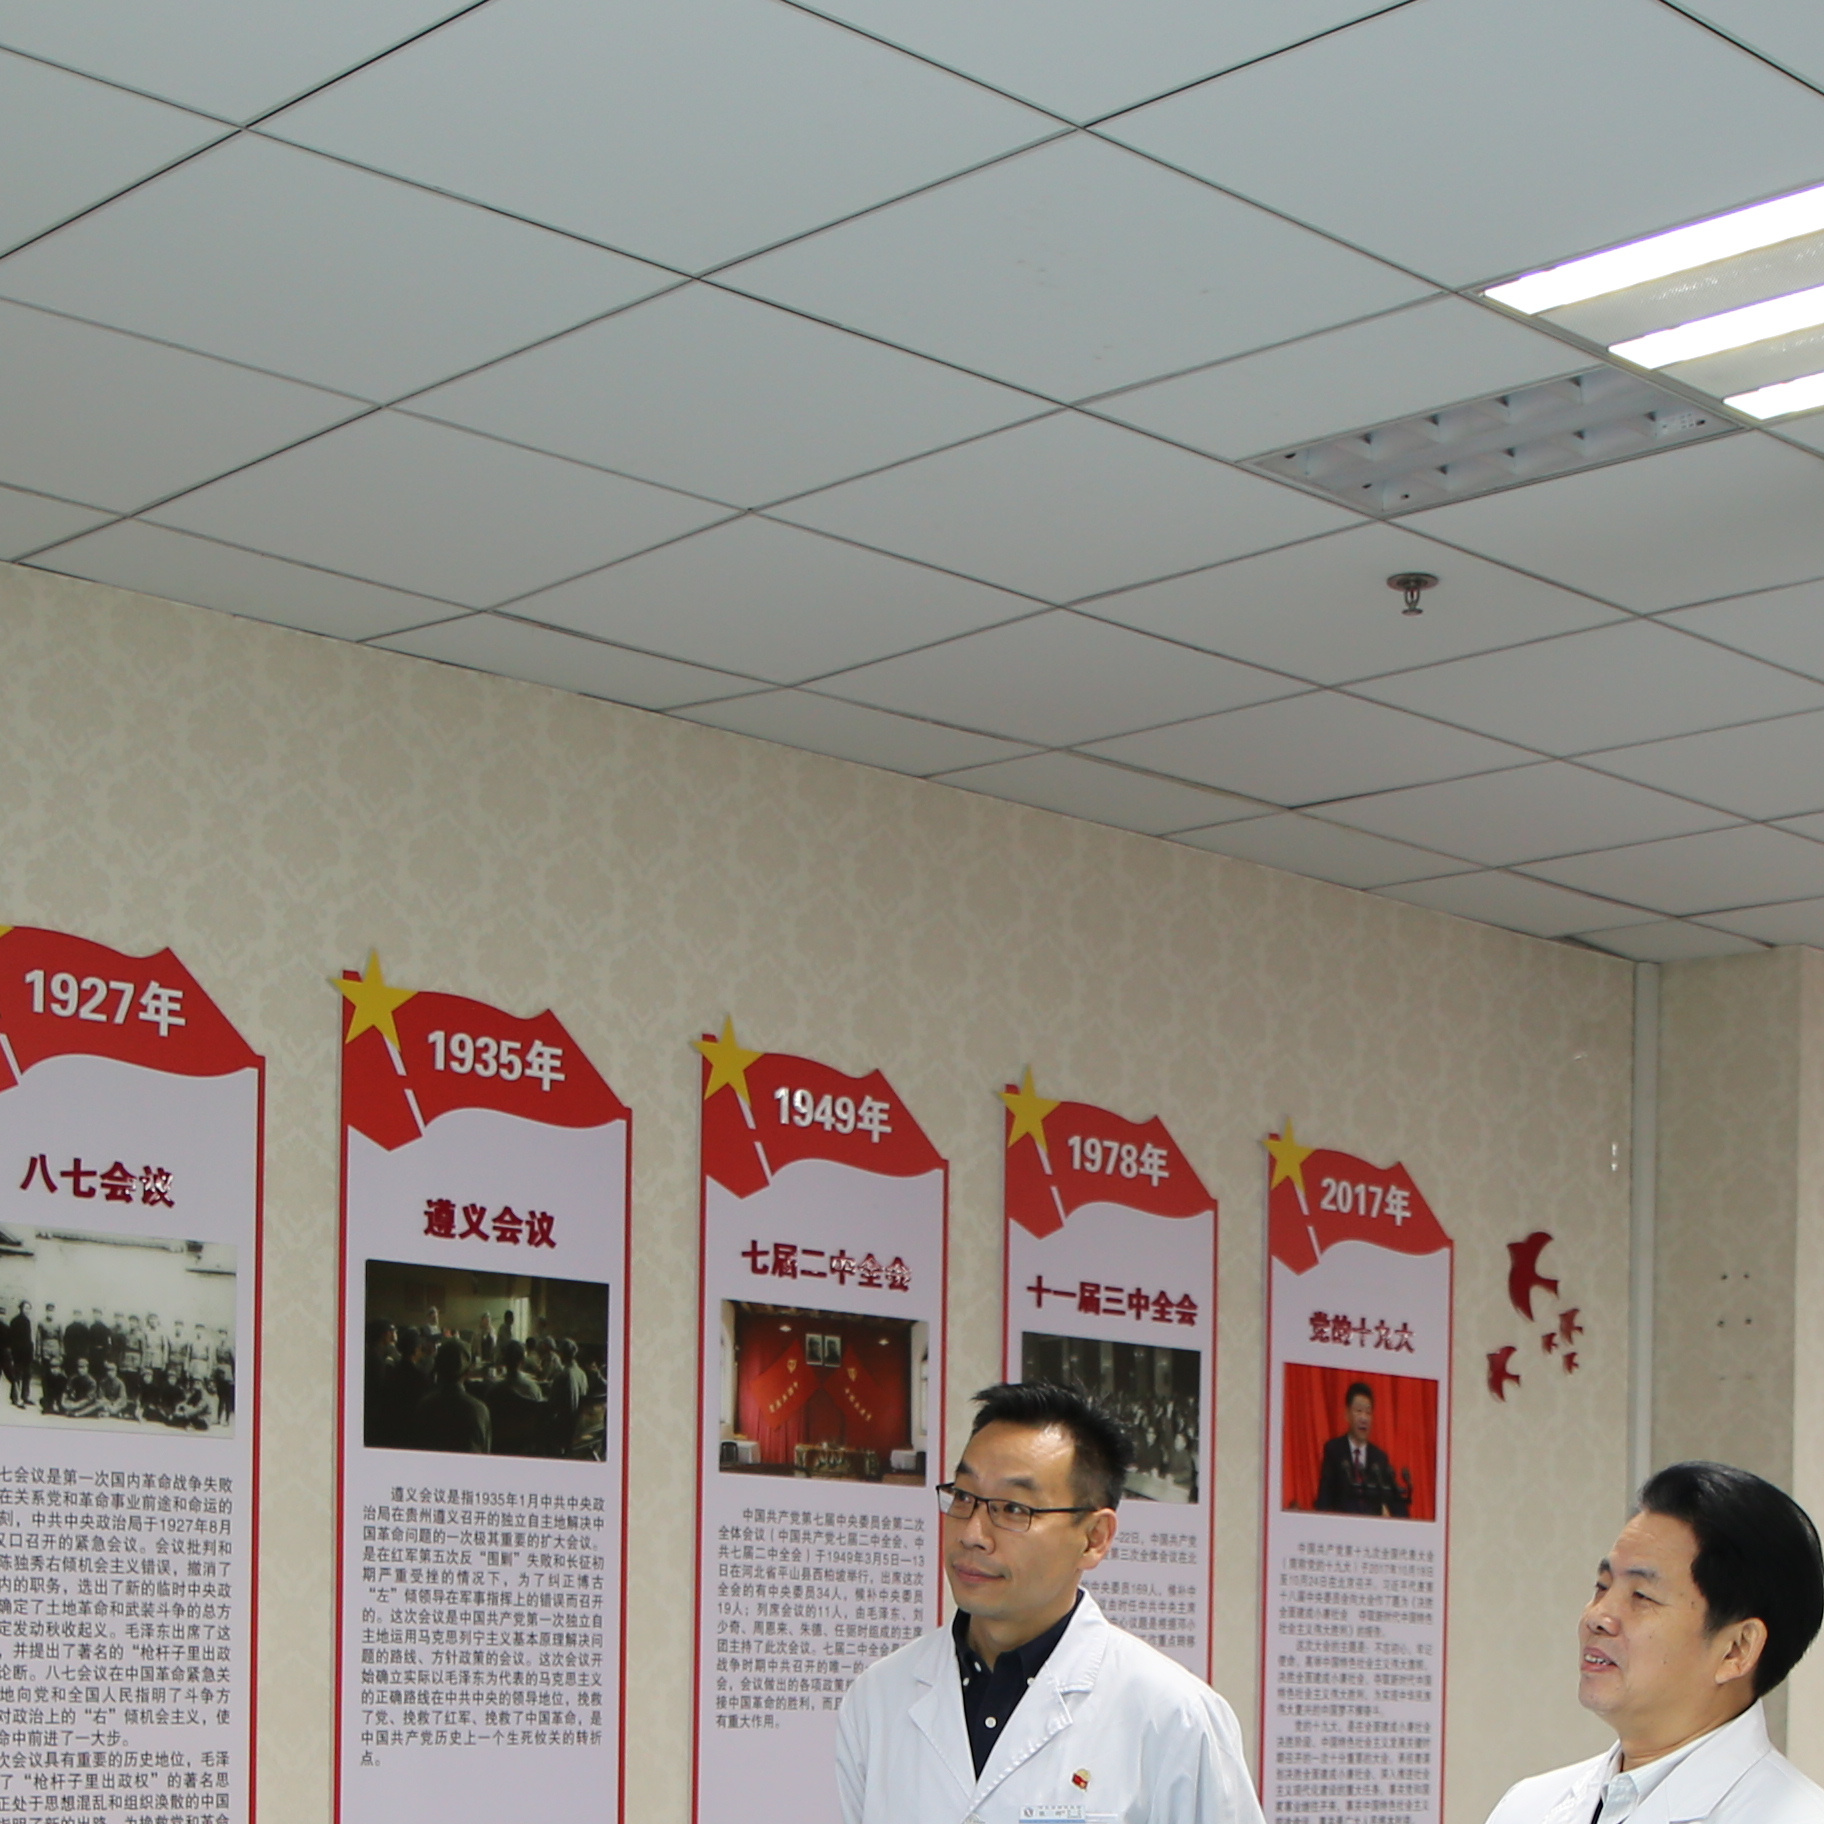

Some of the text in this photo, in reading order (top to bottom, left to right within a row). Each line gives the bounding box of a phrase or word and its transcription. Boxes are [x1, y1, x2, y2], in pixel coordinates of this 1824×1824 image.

[24, 968, 186, 1036] 1927年
[429, 1030, 566, 1090] 1935年
[775, 1087, 892, 1142] 1949年
[20, 1153, 176, 1209] 八七会议
[1068, 1135, 1170, 1187] 1978年
[423, 1198, 557, 1249] 遵义会议
[1320, 1178, 1412, 1226] 2017年
[1026, 1275, 1198, 1327] 十一届三中全会
[1309, 1310, 1415, 1353] 党的十九大
